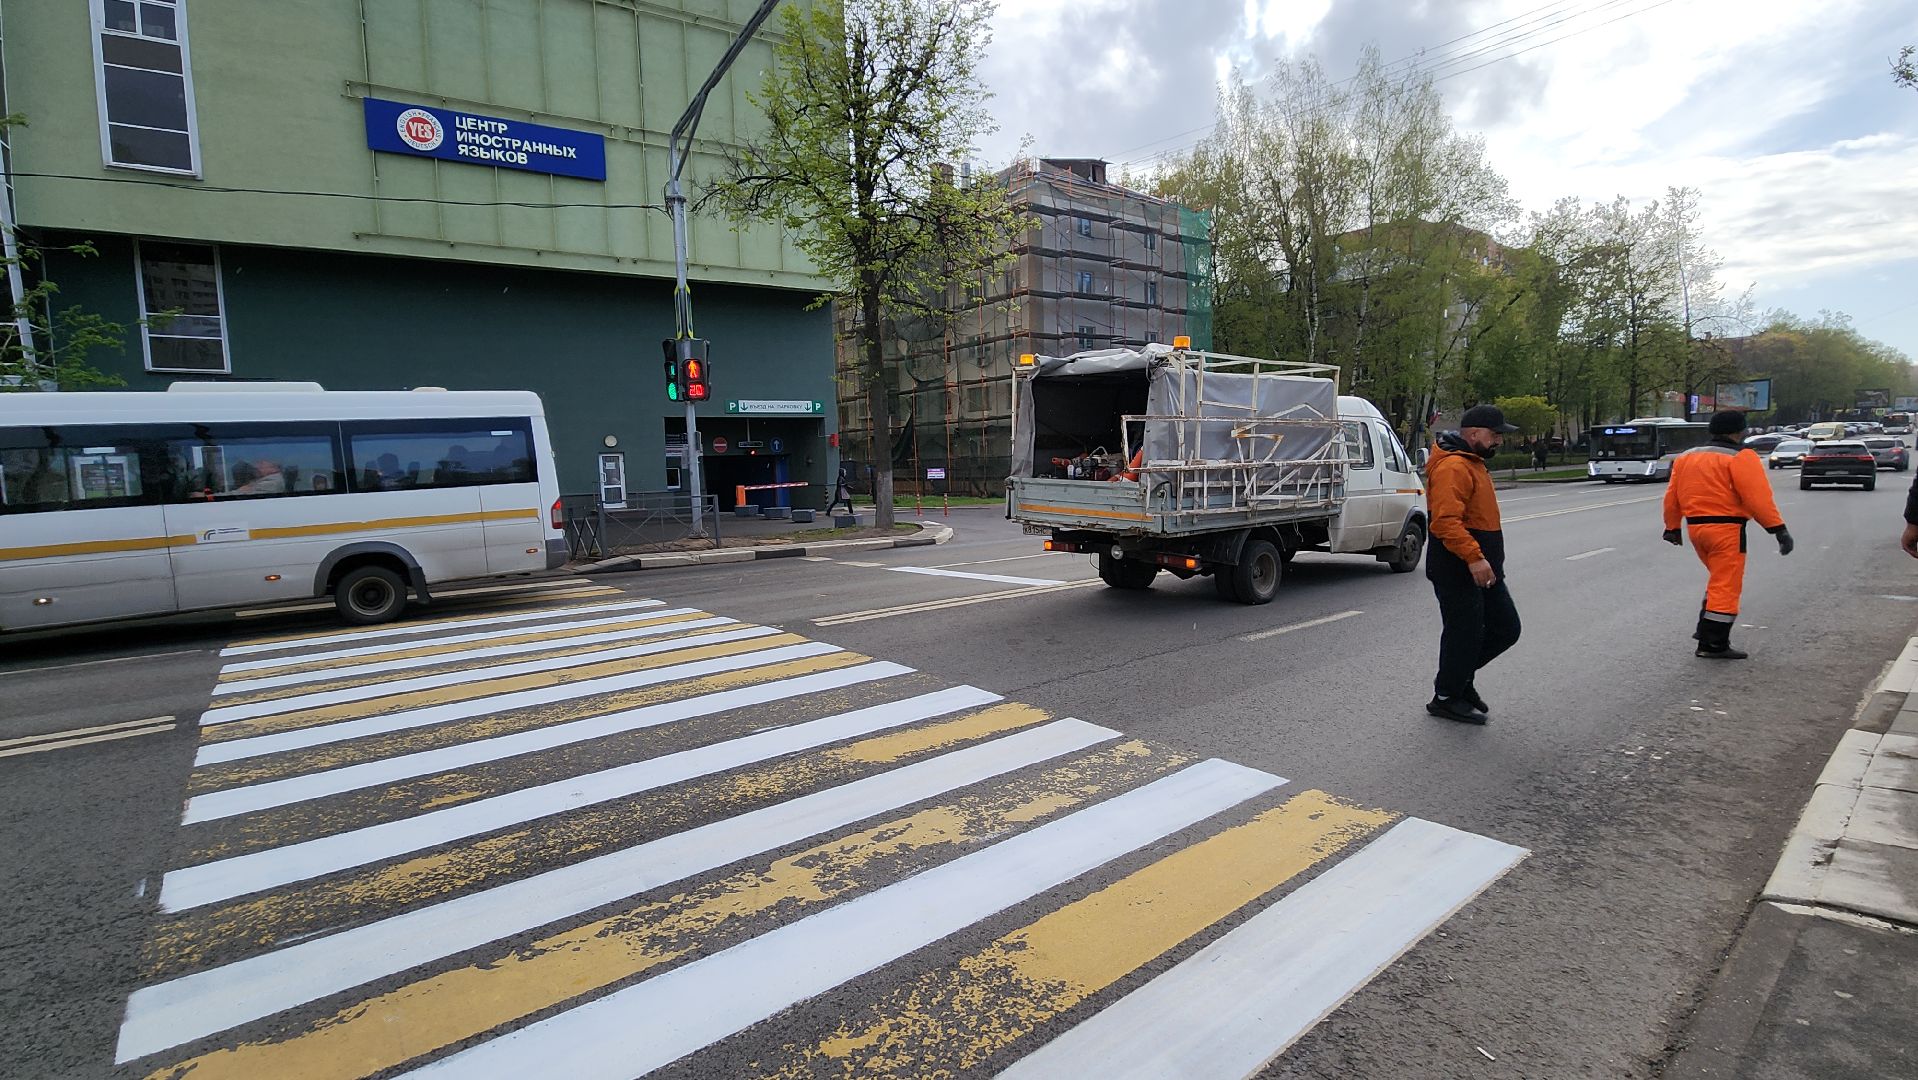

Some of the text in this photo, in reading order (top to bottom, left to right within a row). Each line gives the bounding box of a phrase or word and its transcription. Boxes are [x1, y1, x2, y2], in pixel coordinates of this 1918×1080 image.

[399, 111, 417, 133] ENGLISH
[408, 121, 433, 139] YES
[455, 115, 508, 134] ЦЕНТР
[456, 130, 577, 159] ИНОСТРАННЫХ
[457, 144, 528, 165] ЯЗЫКОВ
[689, 384, 703, 396] 20
